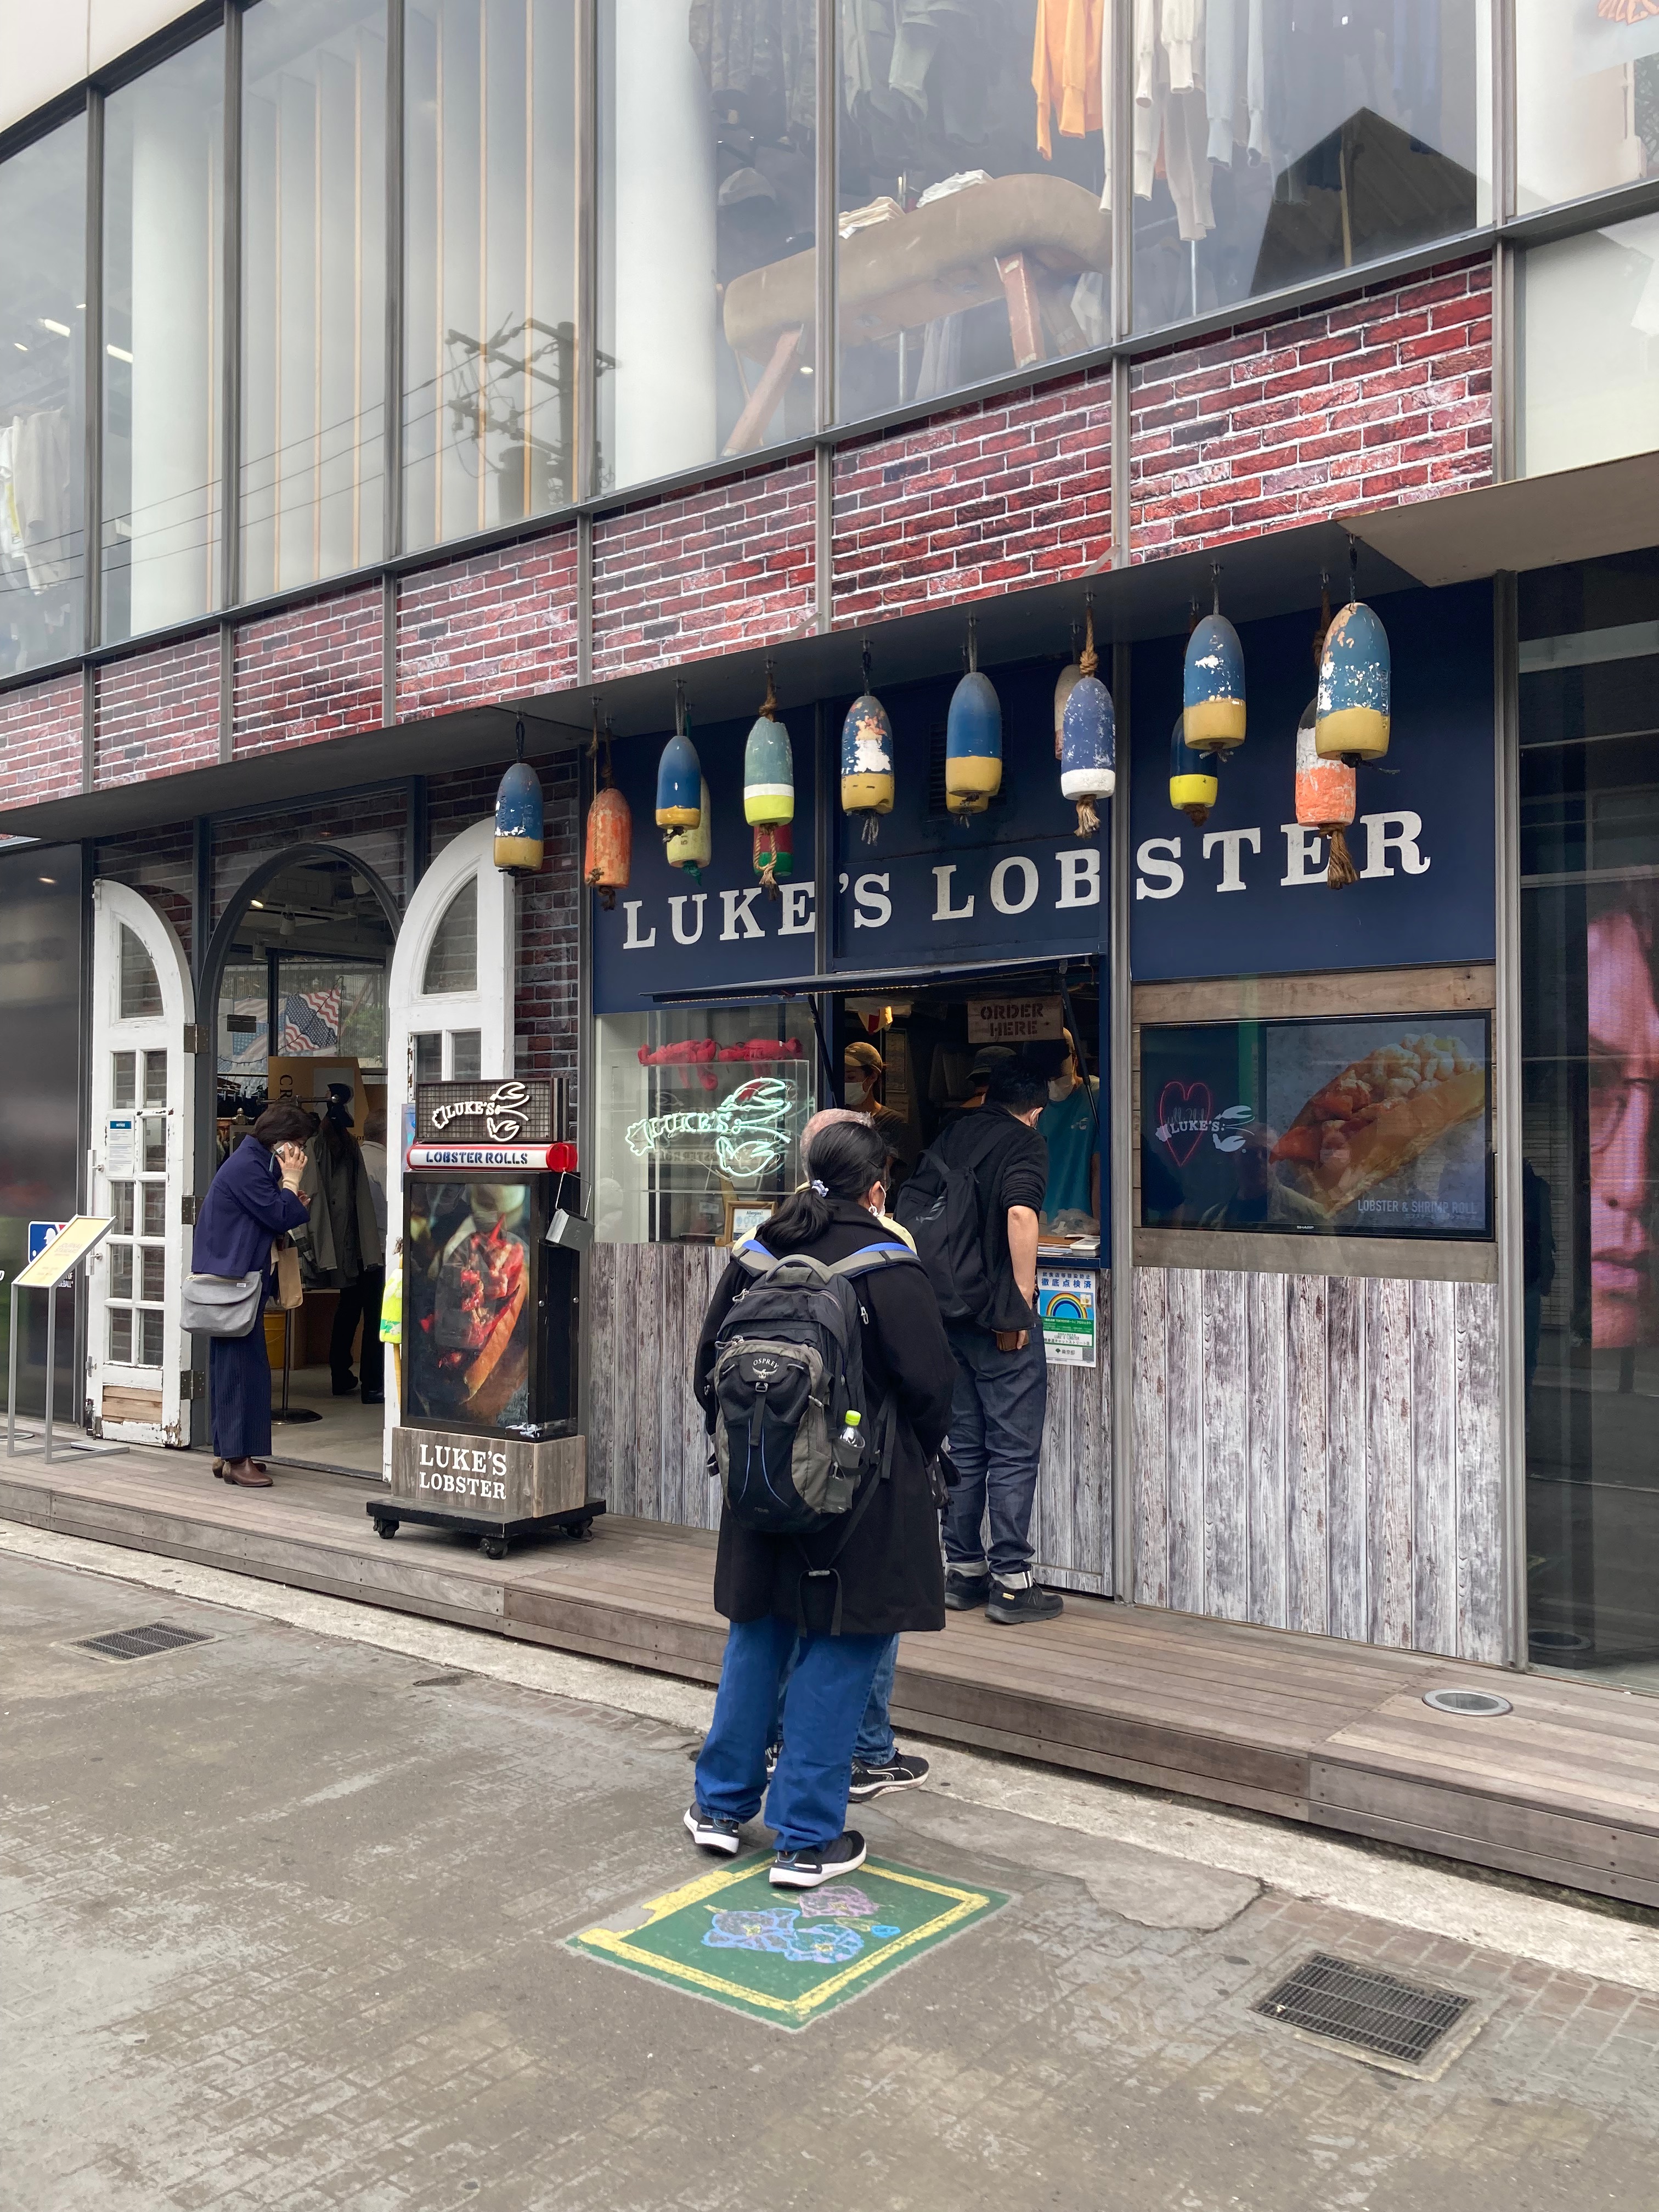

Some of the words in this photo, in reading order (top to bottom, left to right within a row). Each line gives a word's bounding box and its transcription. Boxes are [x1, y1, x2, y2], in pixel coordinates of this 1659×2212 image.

[623, 872, 892, 950] LUKE'S
[932, 811, 1431, 921] LOBSTER
[980, 1003, 1043, 1020] ORDER
[990, 1020, 1038, 1037] HERE
[446, 1101, 495, 1119] LUKE'S
[1170, 1120, 1220, 1134] LUKE'S
[426, 1151, 484, 1164] LOBSTER
[486, 1152, 528, 1164] ROLLS
[1358, 1199, 1398, 1212] LOBSTER
[1402, 1201, 1409, 1212] &
[1412, 1201, 1448, 1214] SHRIMP
[1452, 1202, 1477, 1214] ROLL
[1042, 1278, 1091, 1289] 徹底点検済
[753, 1358, 780, 1369] OSPREY
[419, 1443, 507, 1476] LUKE'S
[419, 1471, 506, 1500] LOBSTER
